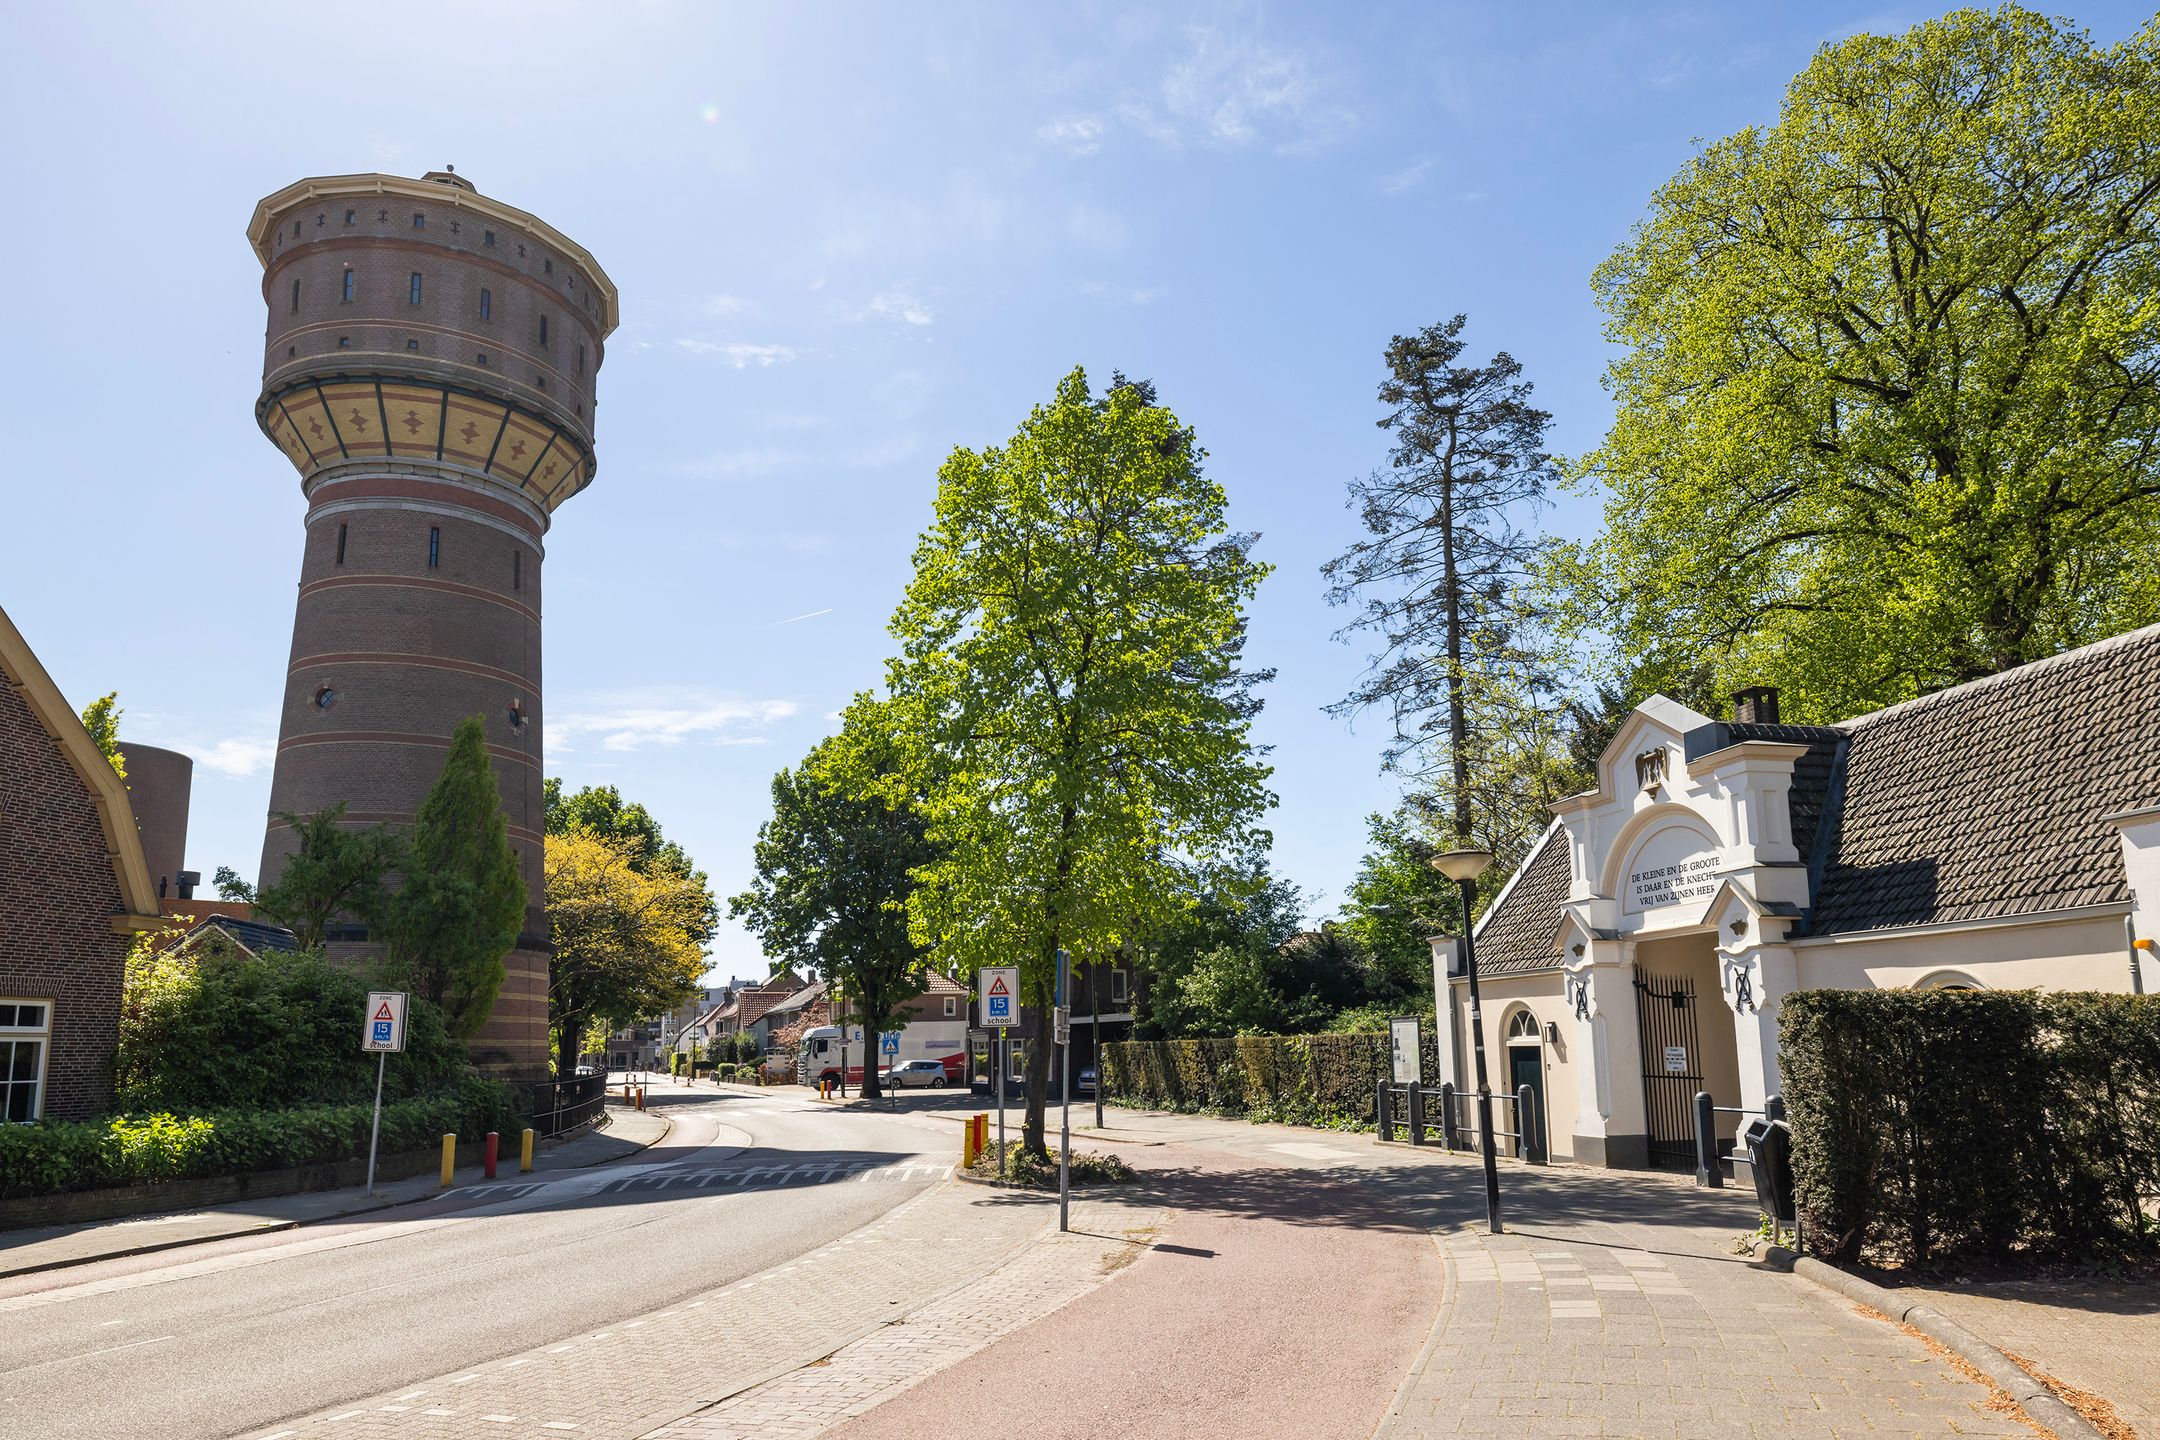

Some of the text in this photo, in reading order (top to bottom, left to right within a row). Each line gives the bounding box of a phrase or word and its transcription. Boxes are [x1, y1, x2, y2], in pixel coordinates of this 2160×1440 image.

[1632, 857, 1720, 882] DE KLEINE EN DE GROOTE
[1636, 886, 1642, 894] IS
[1644, 882, 1664, 892] DAAR
[1664, 880, 1673, 888] EN
[1676, 877, 1684, 886] DE
[1640, 895, 1654, 906] VRIJ
[1655, 892, 1670, 902] VAN
[993, 998, 1005, 1008] 15
[377, 1024, 388, 1033] 15
